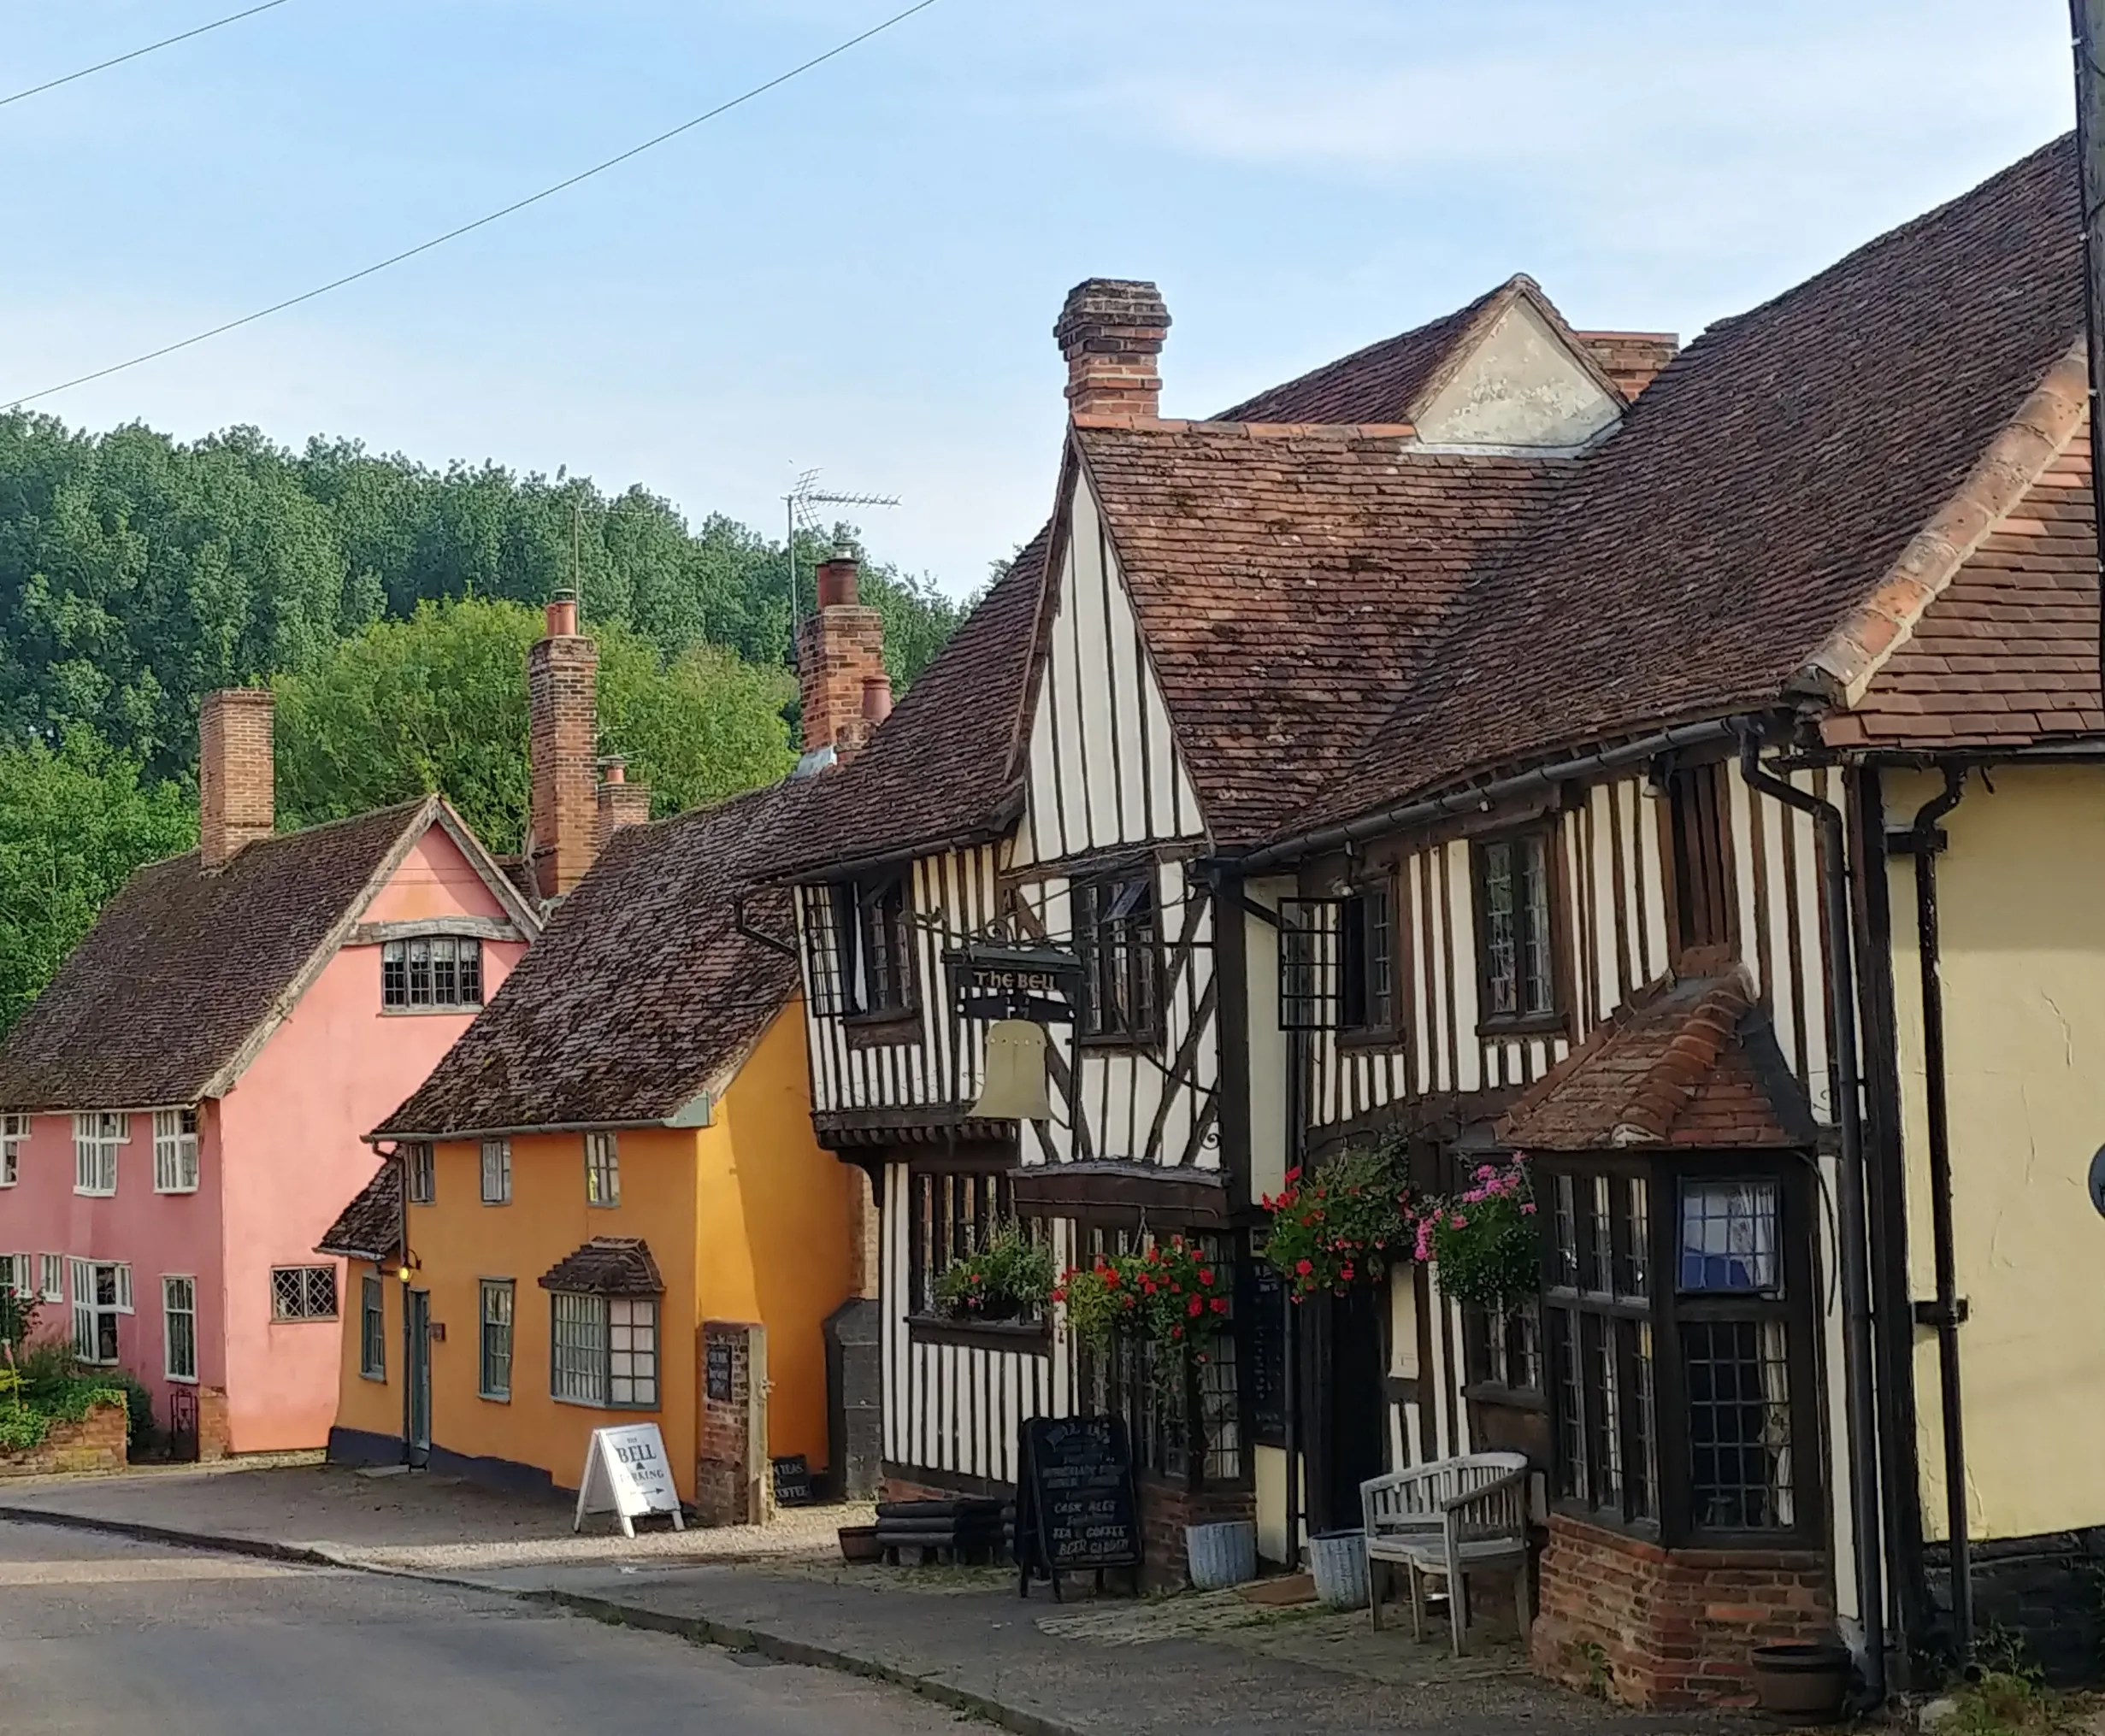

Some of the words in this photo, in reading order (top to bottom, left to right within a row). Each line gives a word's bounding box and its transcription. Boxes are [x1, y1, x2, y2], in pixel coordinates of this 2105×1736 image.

[1017, 973, 1055, 991] Bell
[616, 1444, 657, 1463] BELL
[619, 1468, 664, 1482] RKING
